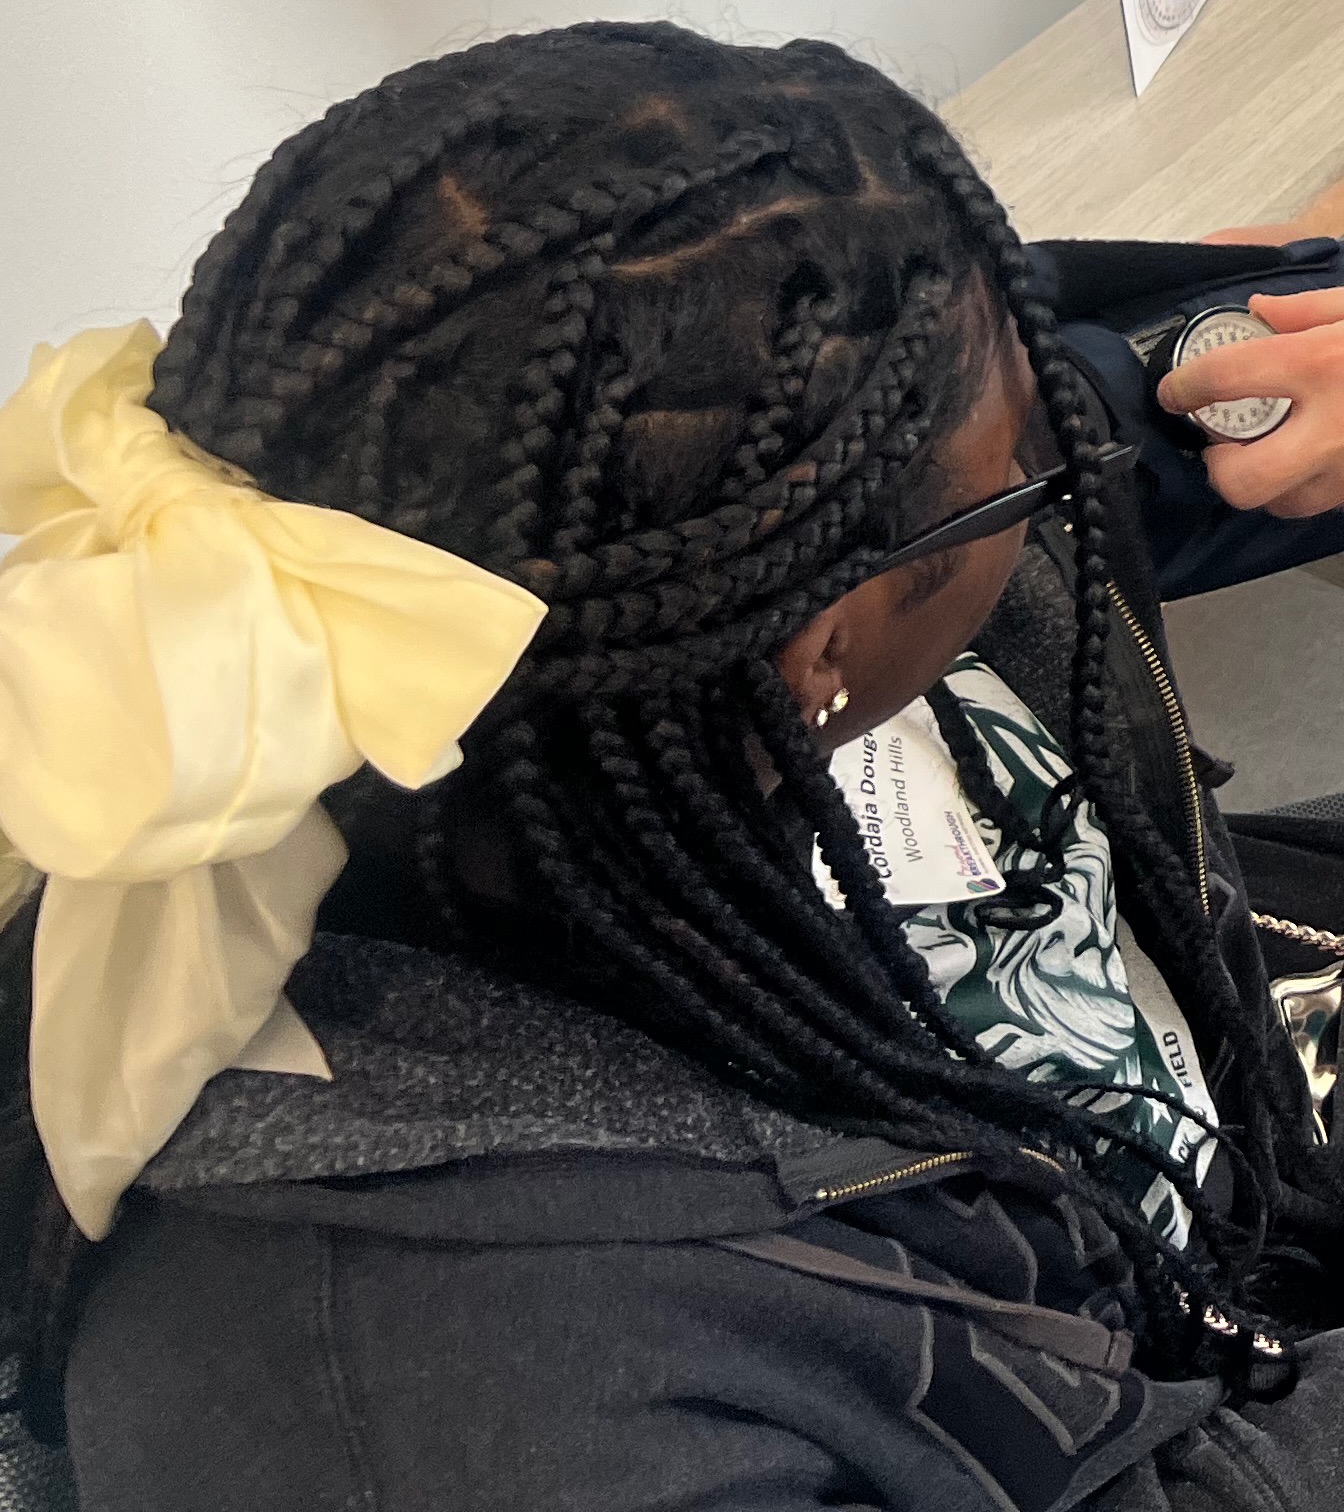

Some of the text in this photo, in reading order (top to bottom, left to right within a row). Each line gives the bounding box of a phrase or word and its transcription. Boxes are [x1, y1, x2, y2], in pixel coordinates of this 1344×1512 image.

[860, 731, 878, 795] Doug
[888, 736, 924, 863] Woodland Hills
[1163, 1030, 1193, 1088] FIELD
